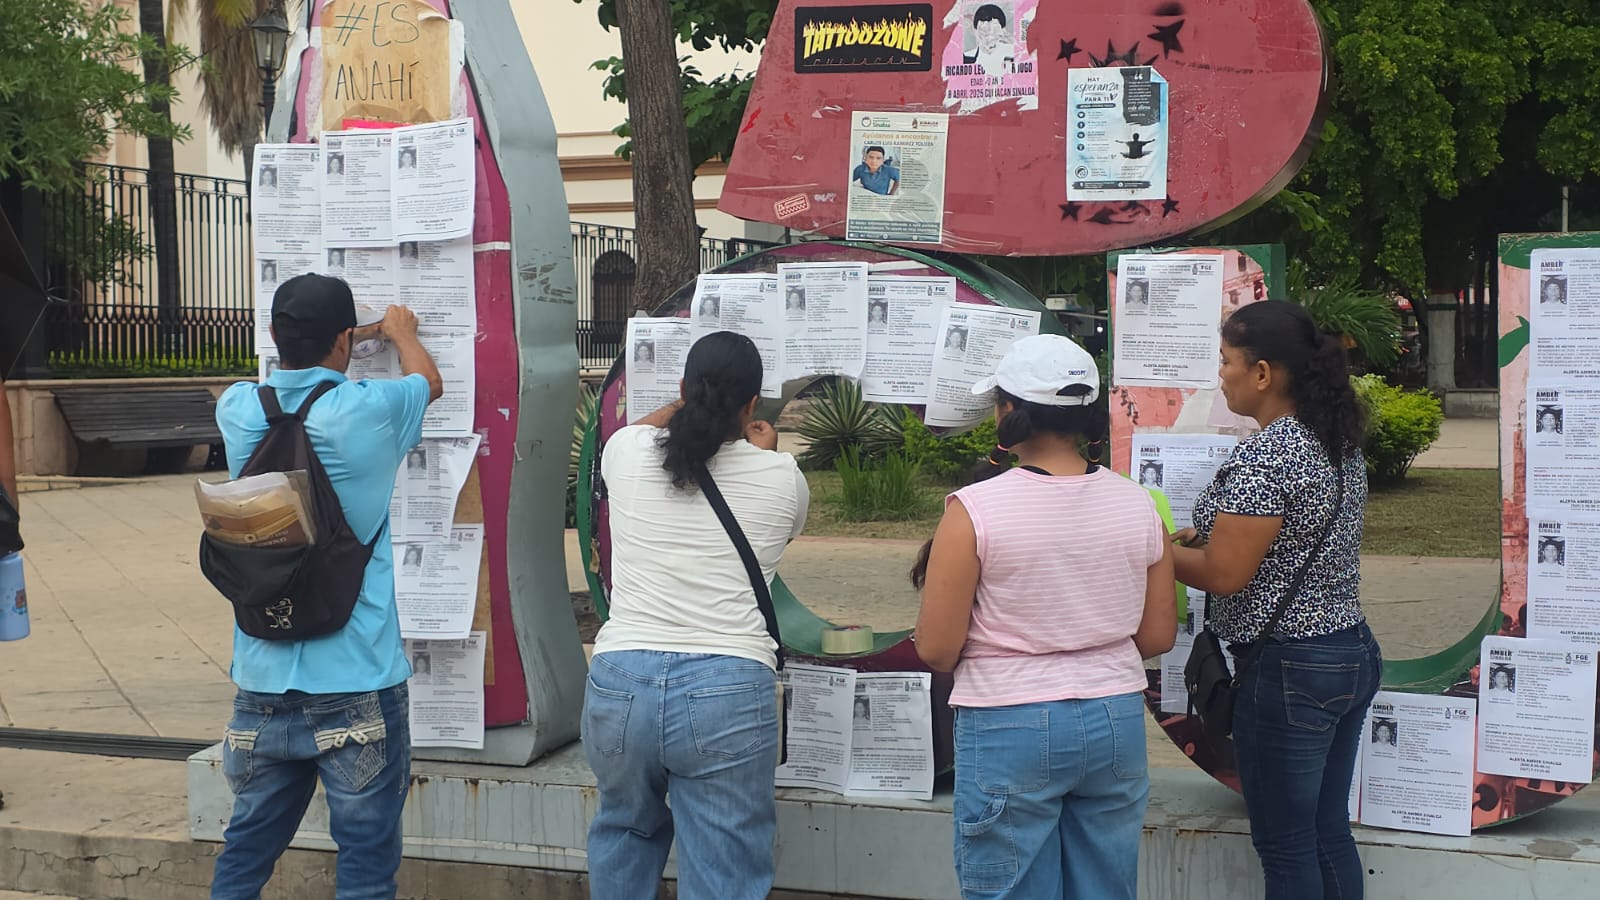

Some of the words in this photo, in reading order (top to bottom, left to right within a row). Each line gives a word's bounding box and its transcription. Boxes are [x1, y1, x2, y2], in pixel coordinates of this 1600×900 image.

[335, 2, 419, 47] #ES
[803, 15, 926, 59] TATTOOZONE
[945, 65, 971, 76] RICARDO
[335, 60, 420, 101] ANAHÍ
[1011, 86, 1034, 96] SINALOA
[1073, 82, 1119, 98] esperanza
[1540, 260, 1563, 268] AMBER
[1490, 649, 1513, 657] AMBER
[1372, 703, 1394, 711] AMBER
